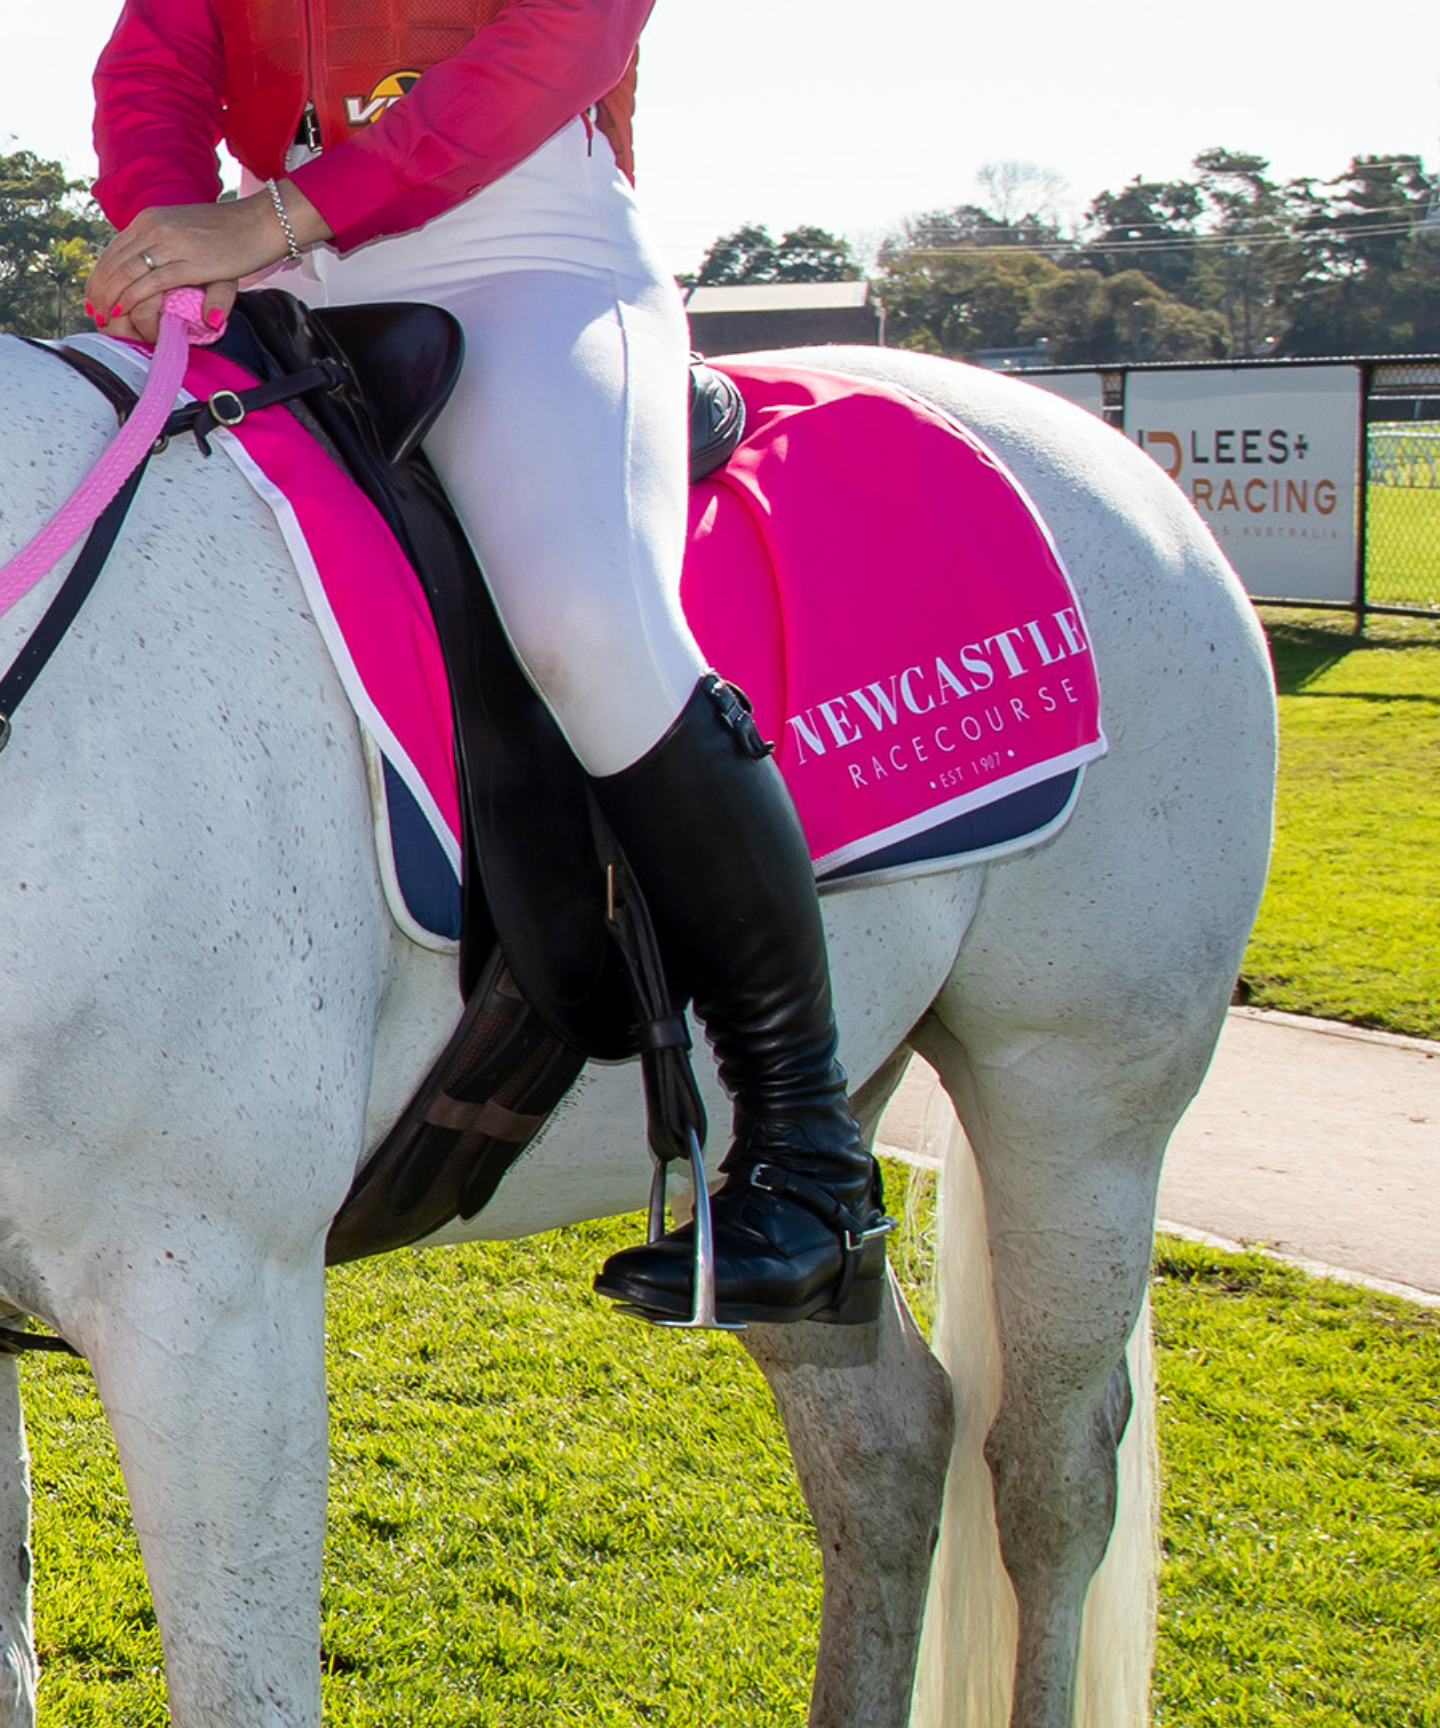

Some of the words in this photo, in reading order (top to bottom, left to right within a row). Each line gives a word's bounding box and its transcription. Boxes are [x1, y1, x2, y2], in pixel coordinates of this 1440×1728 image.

[1192, 477, 1337, 515] RACING
[786, 607, 1088, 765] NEWCASTLE
[848, 678, 1078, 789] RACECOURSE
[939, 766, 964, 789] EST
[971, 751, 1002, 776] 1907
